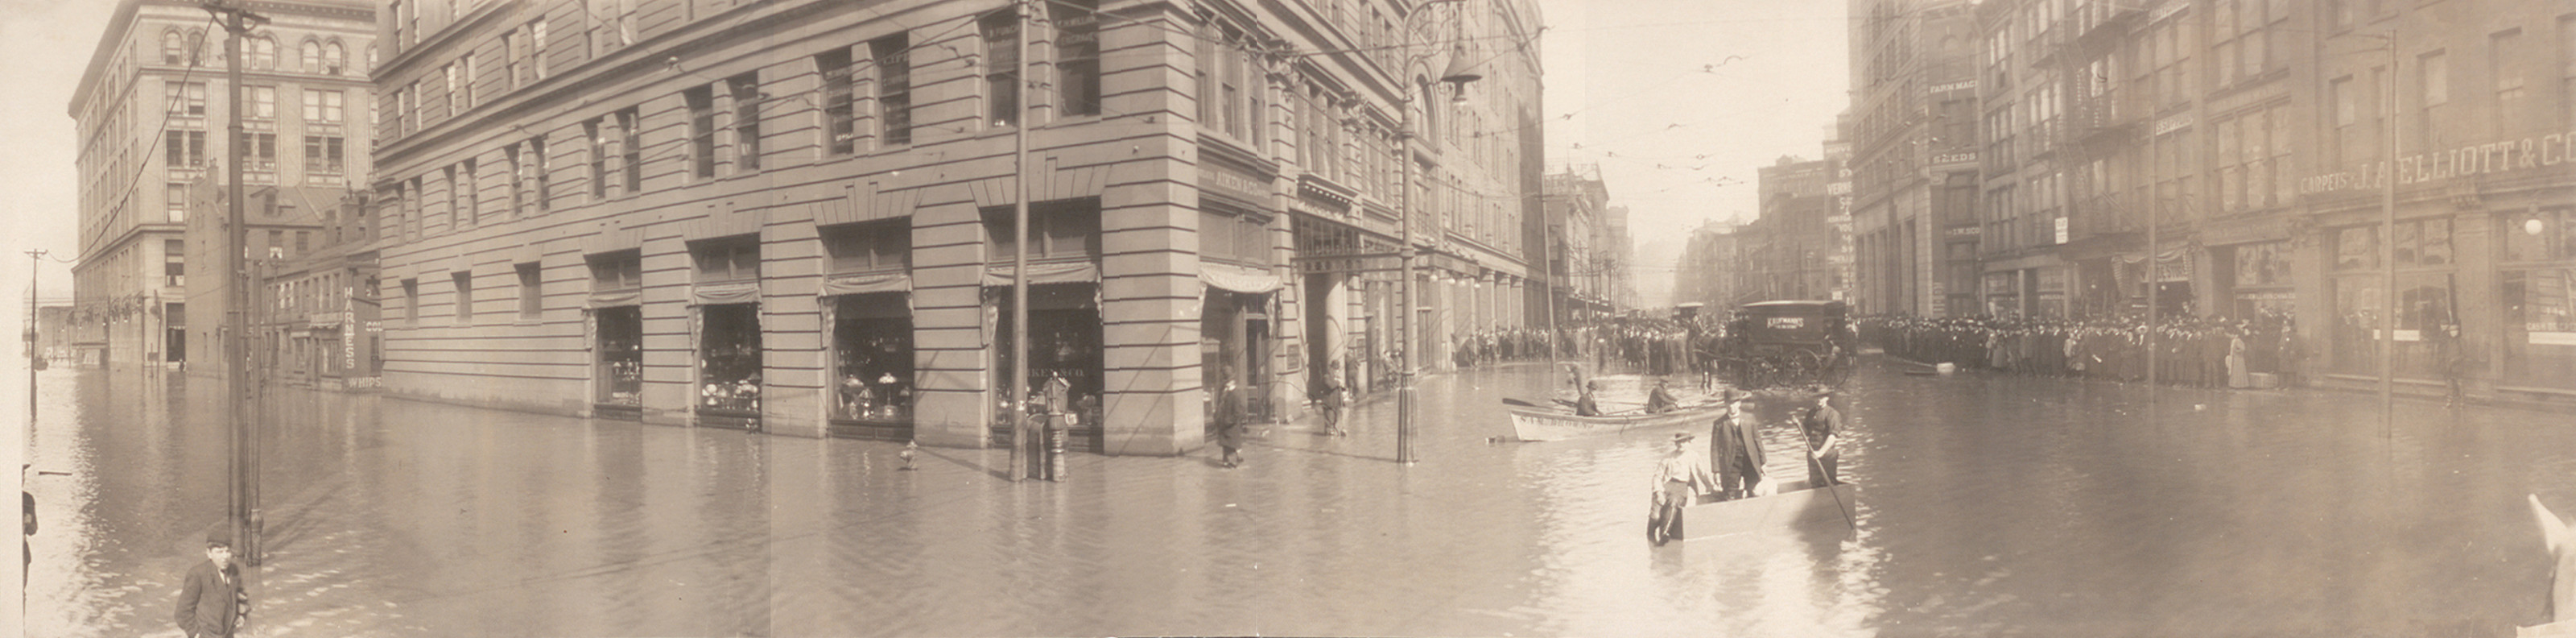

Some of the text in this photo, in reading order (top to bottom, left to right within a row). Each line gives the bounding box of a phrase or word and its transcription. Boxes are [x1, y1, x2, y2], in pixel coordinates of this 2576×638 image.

[1933, 151, 1976, 164] SEEDS
[2301, 172, 2347, 194] CARPETS
[2399, 140, 2514, 184] ELLIOTT
[2519, 138, 2536, 168] &
[344, 286, 356, 369] HARNESS
[348, 377, 382, 387] WHIPS
